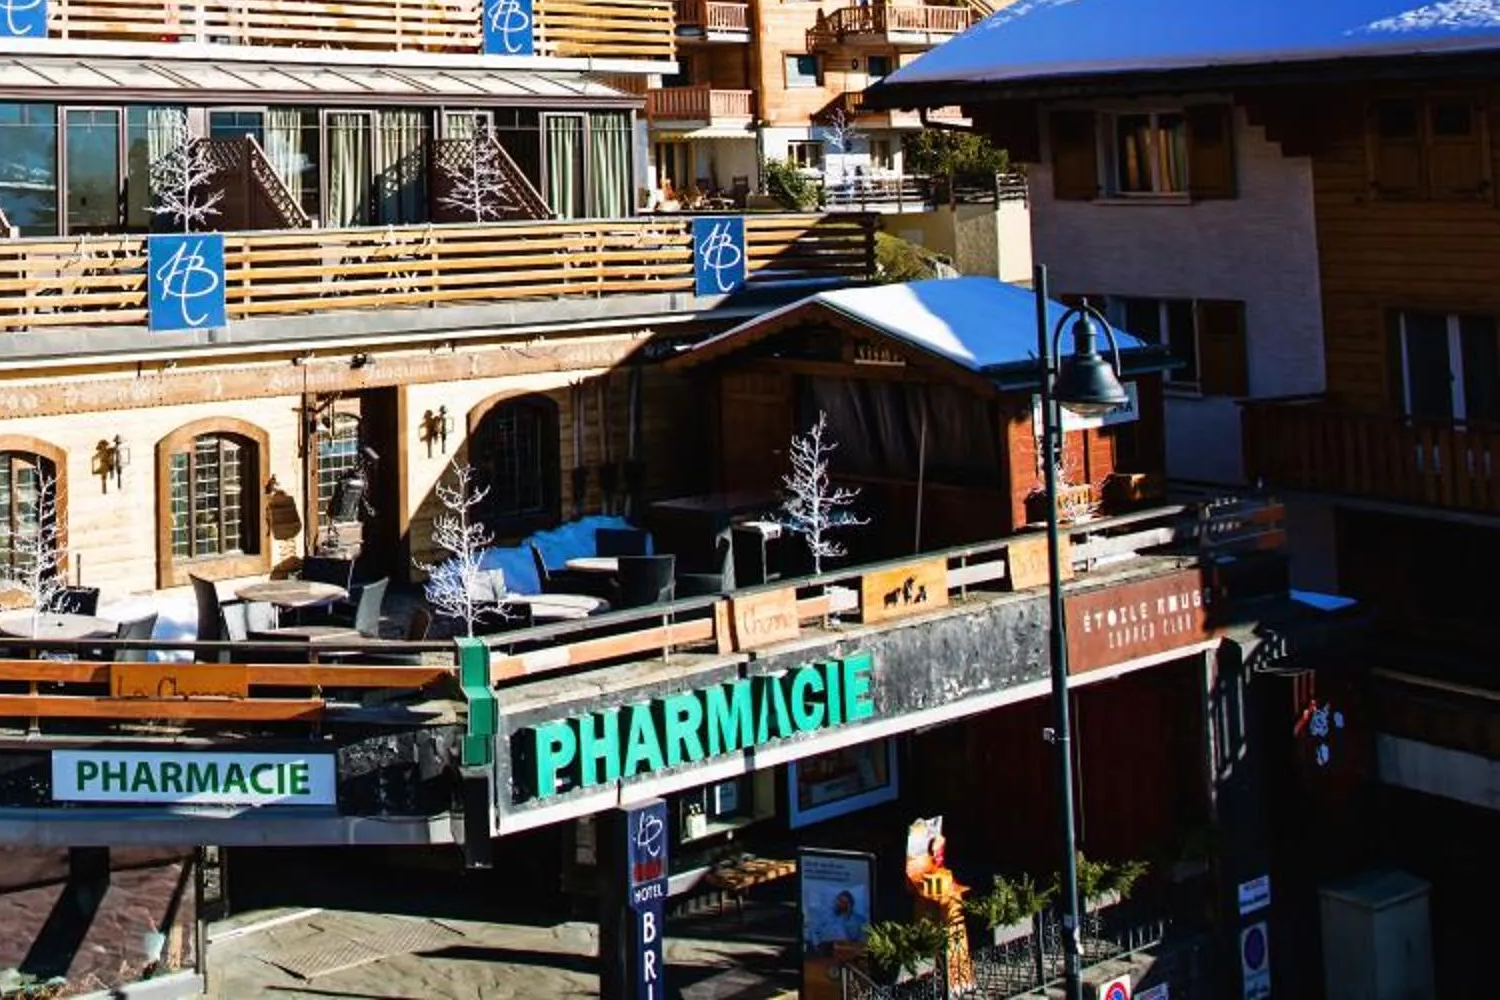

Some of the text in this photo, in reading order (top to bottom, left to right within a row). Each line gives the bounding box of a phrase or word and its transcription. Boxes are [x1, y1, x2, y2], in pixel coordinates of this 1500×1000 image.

[534, 652, 875, 800] PHARMACIE
[75, 760, 312, 795] PHARMACIE
[634, 883, 664, 904] HOTEL
